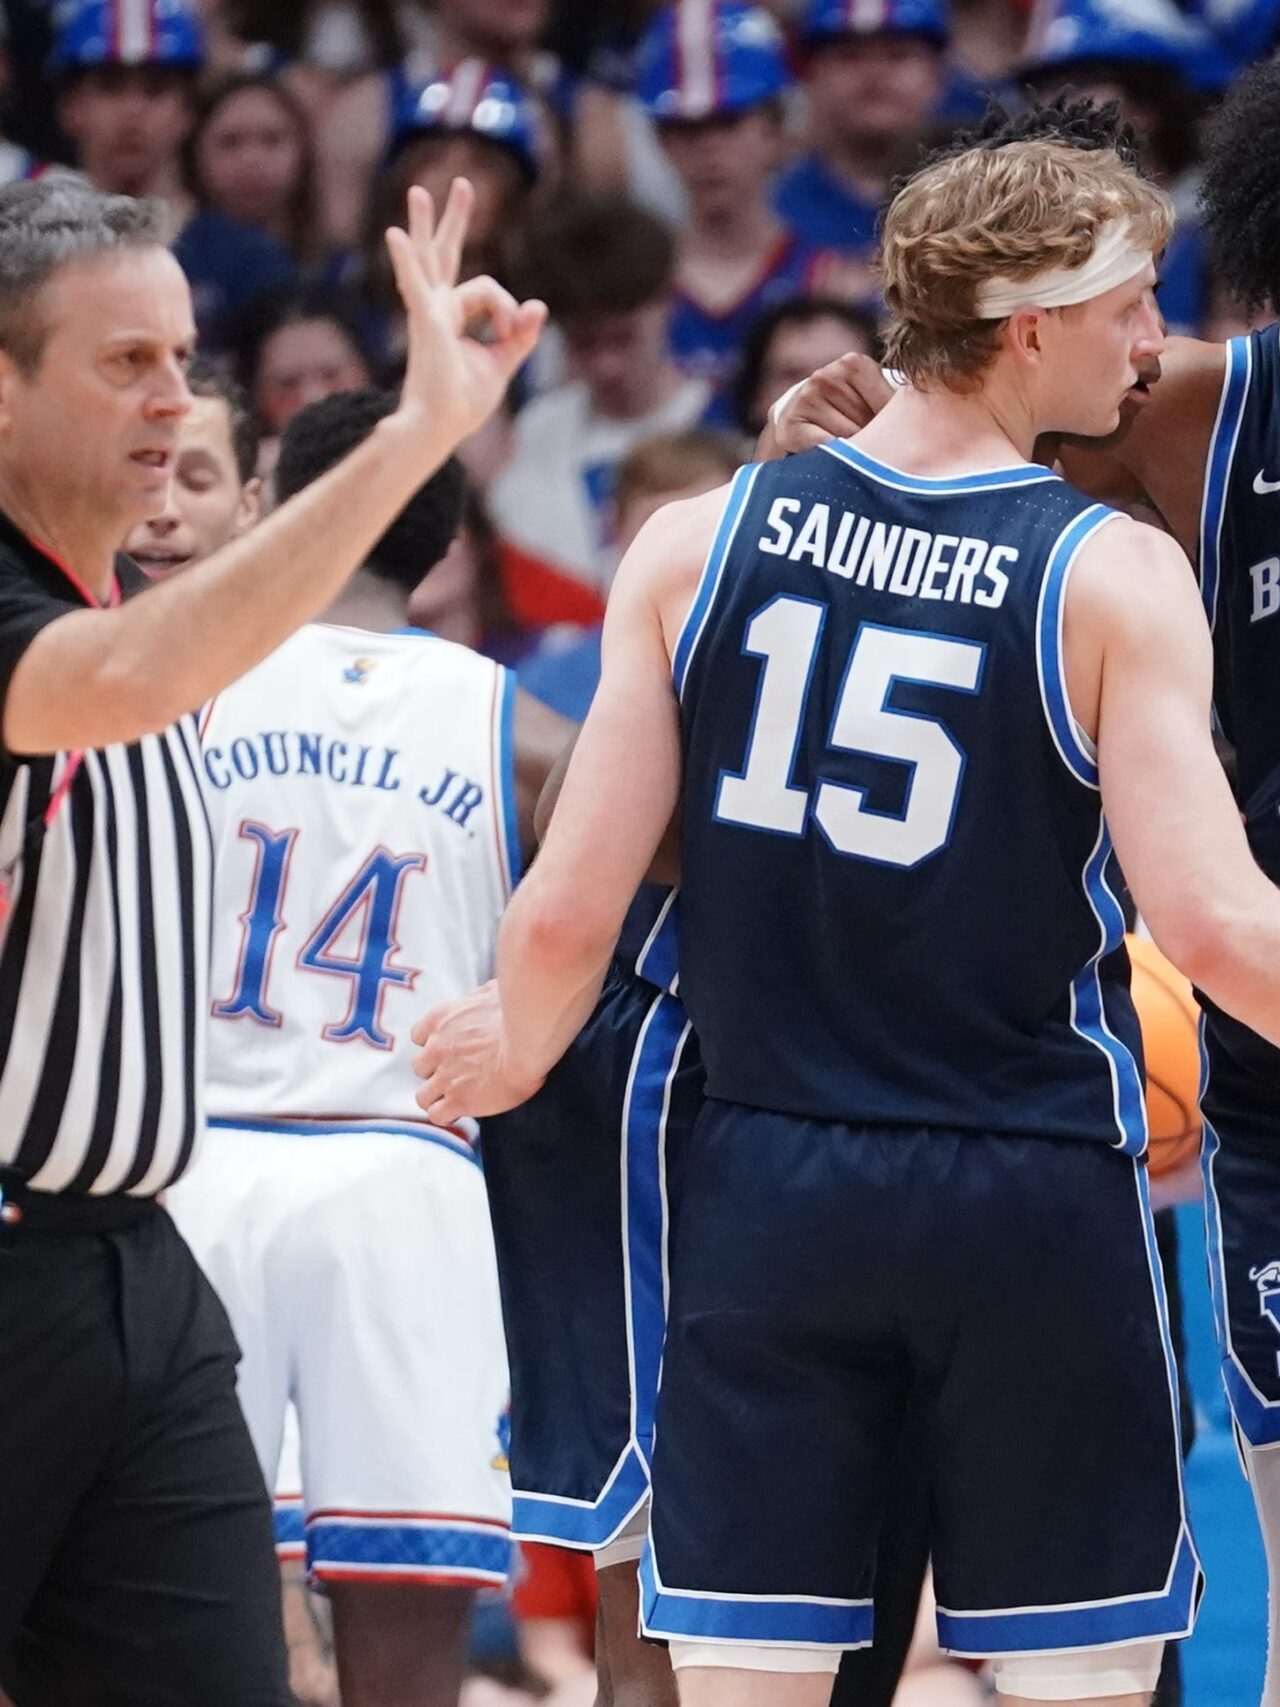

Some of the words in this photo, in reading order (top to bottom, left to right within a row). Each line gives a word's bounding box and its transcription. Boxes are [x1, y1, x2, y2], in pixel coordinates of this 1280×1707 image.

[758, 497, 1020, 609] SAUNDERS
[203, 730, 401, 791] COUNCIL
[419, 767, 484, 839] JR.
[711, 591, 989, 873] 15
[210, 818, 428, 1052] 14
